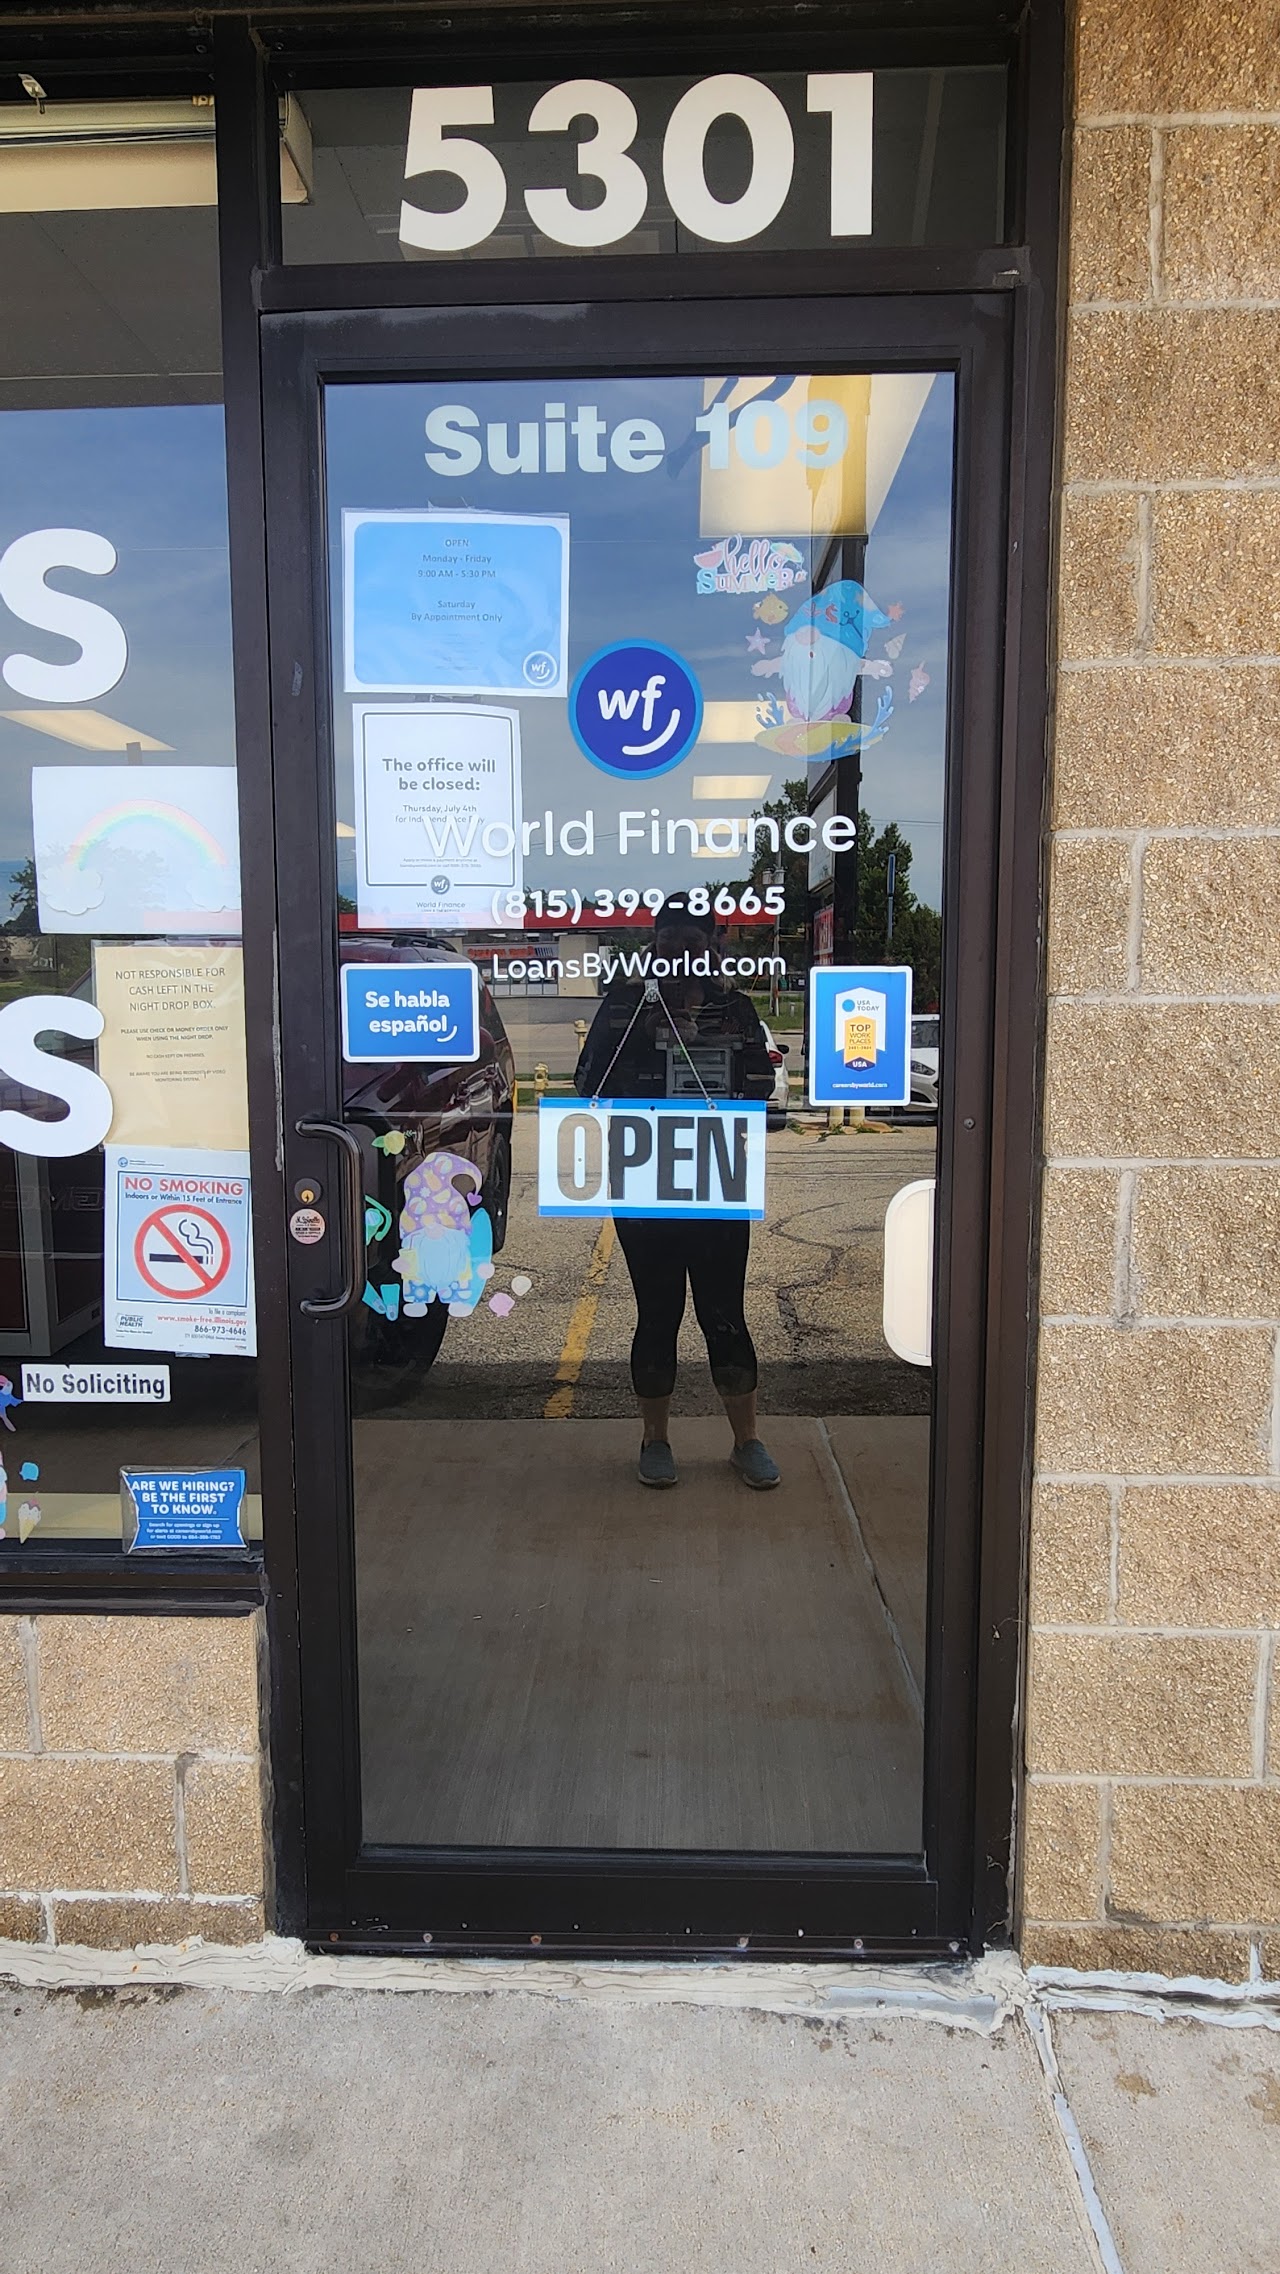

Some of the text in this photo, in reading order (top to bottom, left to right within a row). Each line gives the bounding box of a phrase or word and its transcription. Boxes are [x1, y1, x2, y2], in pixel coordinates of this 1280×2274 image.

[398, 71, 874, 251] 5301
[424, 400, 849, 477] Suite 109
[445, 539, 469, 547] OPEN
[423, 554, 458, 564] Monday
[465, 554, 491, 564] Friday
[461, 570, 479, 578] 5:30
[481, 570, 496, 578] PM
[438, 600, 475, 609] Saturday
[411, 613, 502, 623] By Appointment Only
[598, 675, 666, 731] wf
[382, 757, 496, 772] The office will
[399, 777, 480, 791] be closed:
[403, 805, 442, 813] Thursday,
[444, 805, 460, 813] July
[395, 815, 406, 823] for
[421, 809, 856, 858] World Finance
[492, 886, 786, 925] (815) 399-8665
[492, 950, 786, 985] LoansByWorld.com
[115, 968, 226, 980] NOT RESPONSIBLE FOR
[129, 984, 214, 995] CASH LEFT IN THE
[365, 990, 450, 1008] Se habla
[129, 1000, 216, 1011] NIGHT DROP BOX.
[369, 1015, 447, 1037] español
[850, 1024, 871, 1032] TOP
[557, 1113, 748, 1202] OPEN
[125, 1177, 243, 1196] NO SMOKING
[125, 1192, 149, 1200] Indoors
[160, 1193, 180, 1201] Within
[216, 1197, 242, 1205] Entrance
[194, 1325, 247, 1335] 866-973-4646
[26, 1373, 165, 1399] No Soliciting
[132, 1481, 235, 1492] ARE WE HIRING?
[142, 1493, 226, 1503] BE THE FIRST
[151, 1504, 217, 1515] TO KNOW.
